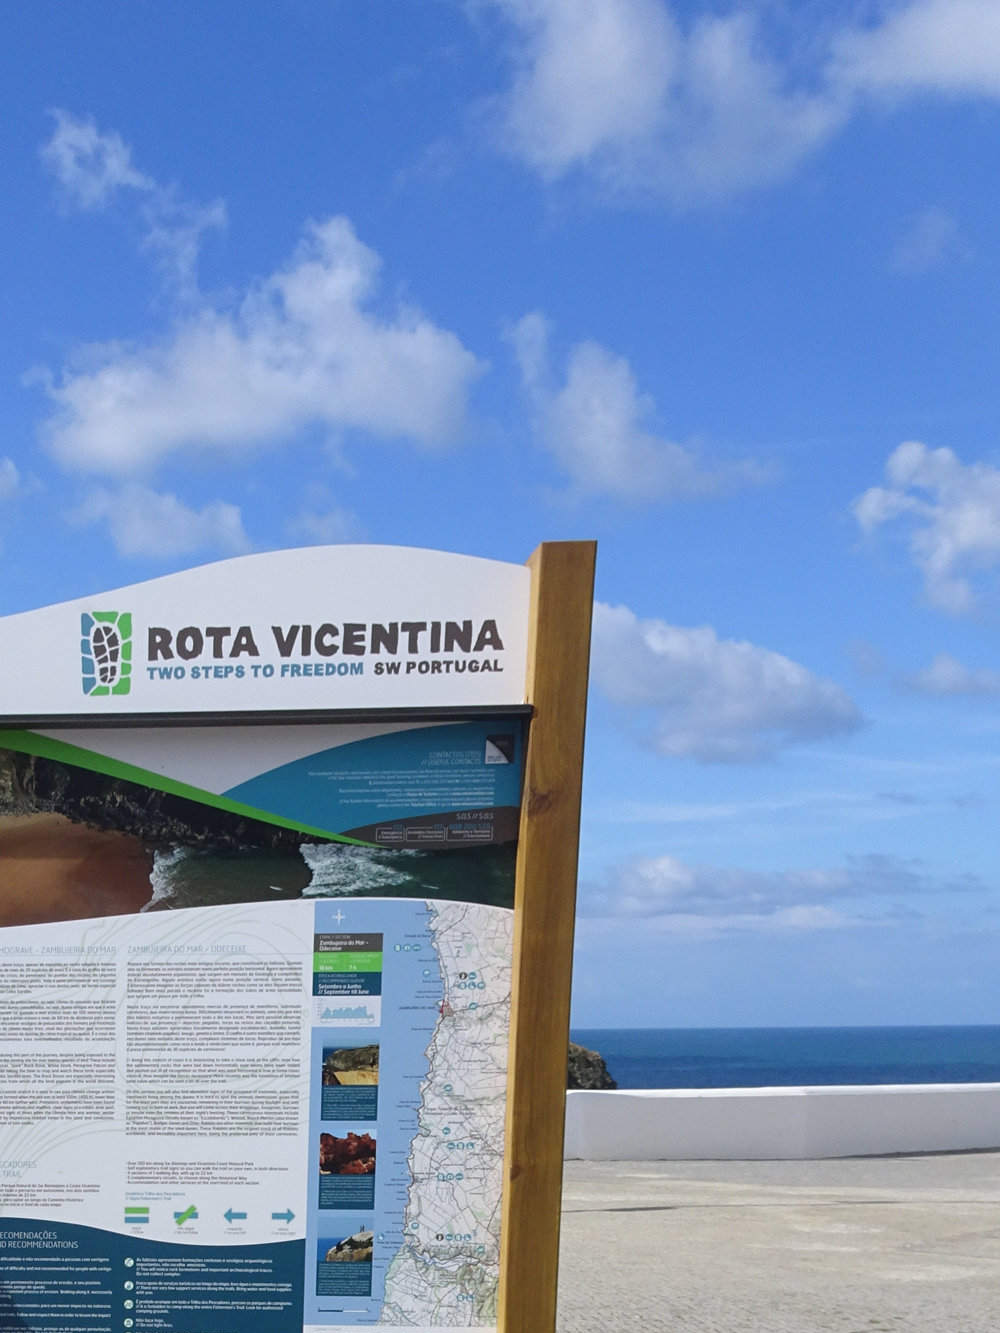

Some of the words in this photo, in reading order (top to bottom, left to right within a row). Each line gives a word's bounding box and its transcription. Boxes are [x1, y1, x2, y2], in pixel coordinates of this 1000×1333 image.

[147, 625, 259, 661] ROTA
[271, 618, 505, 657] VICENTINA
[146, 666, 186, 680] TWO
[191, 664, 246, 680] STEPS
[251, 664, 275, 679] TO
[280, 662, 364, 678] FREEDOM
[374, 661, 401, 676] SW
[405, 659, 504, 674] PORTUGAL
[8, 1241, 79, 1249] RECOMMENDATIONS
